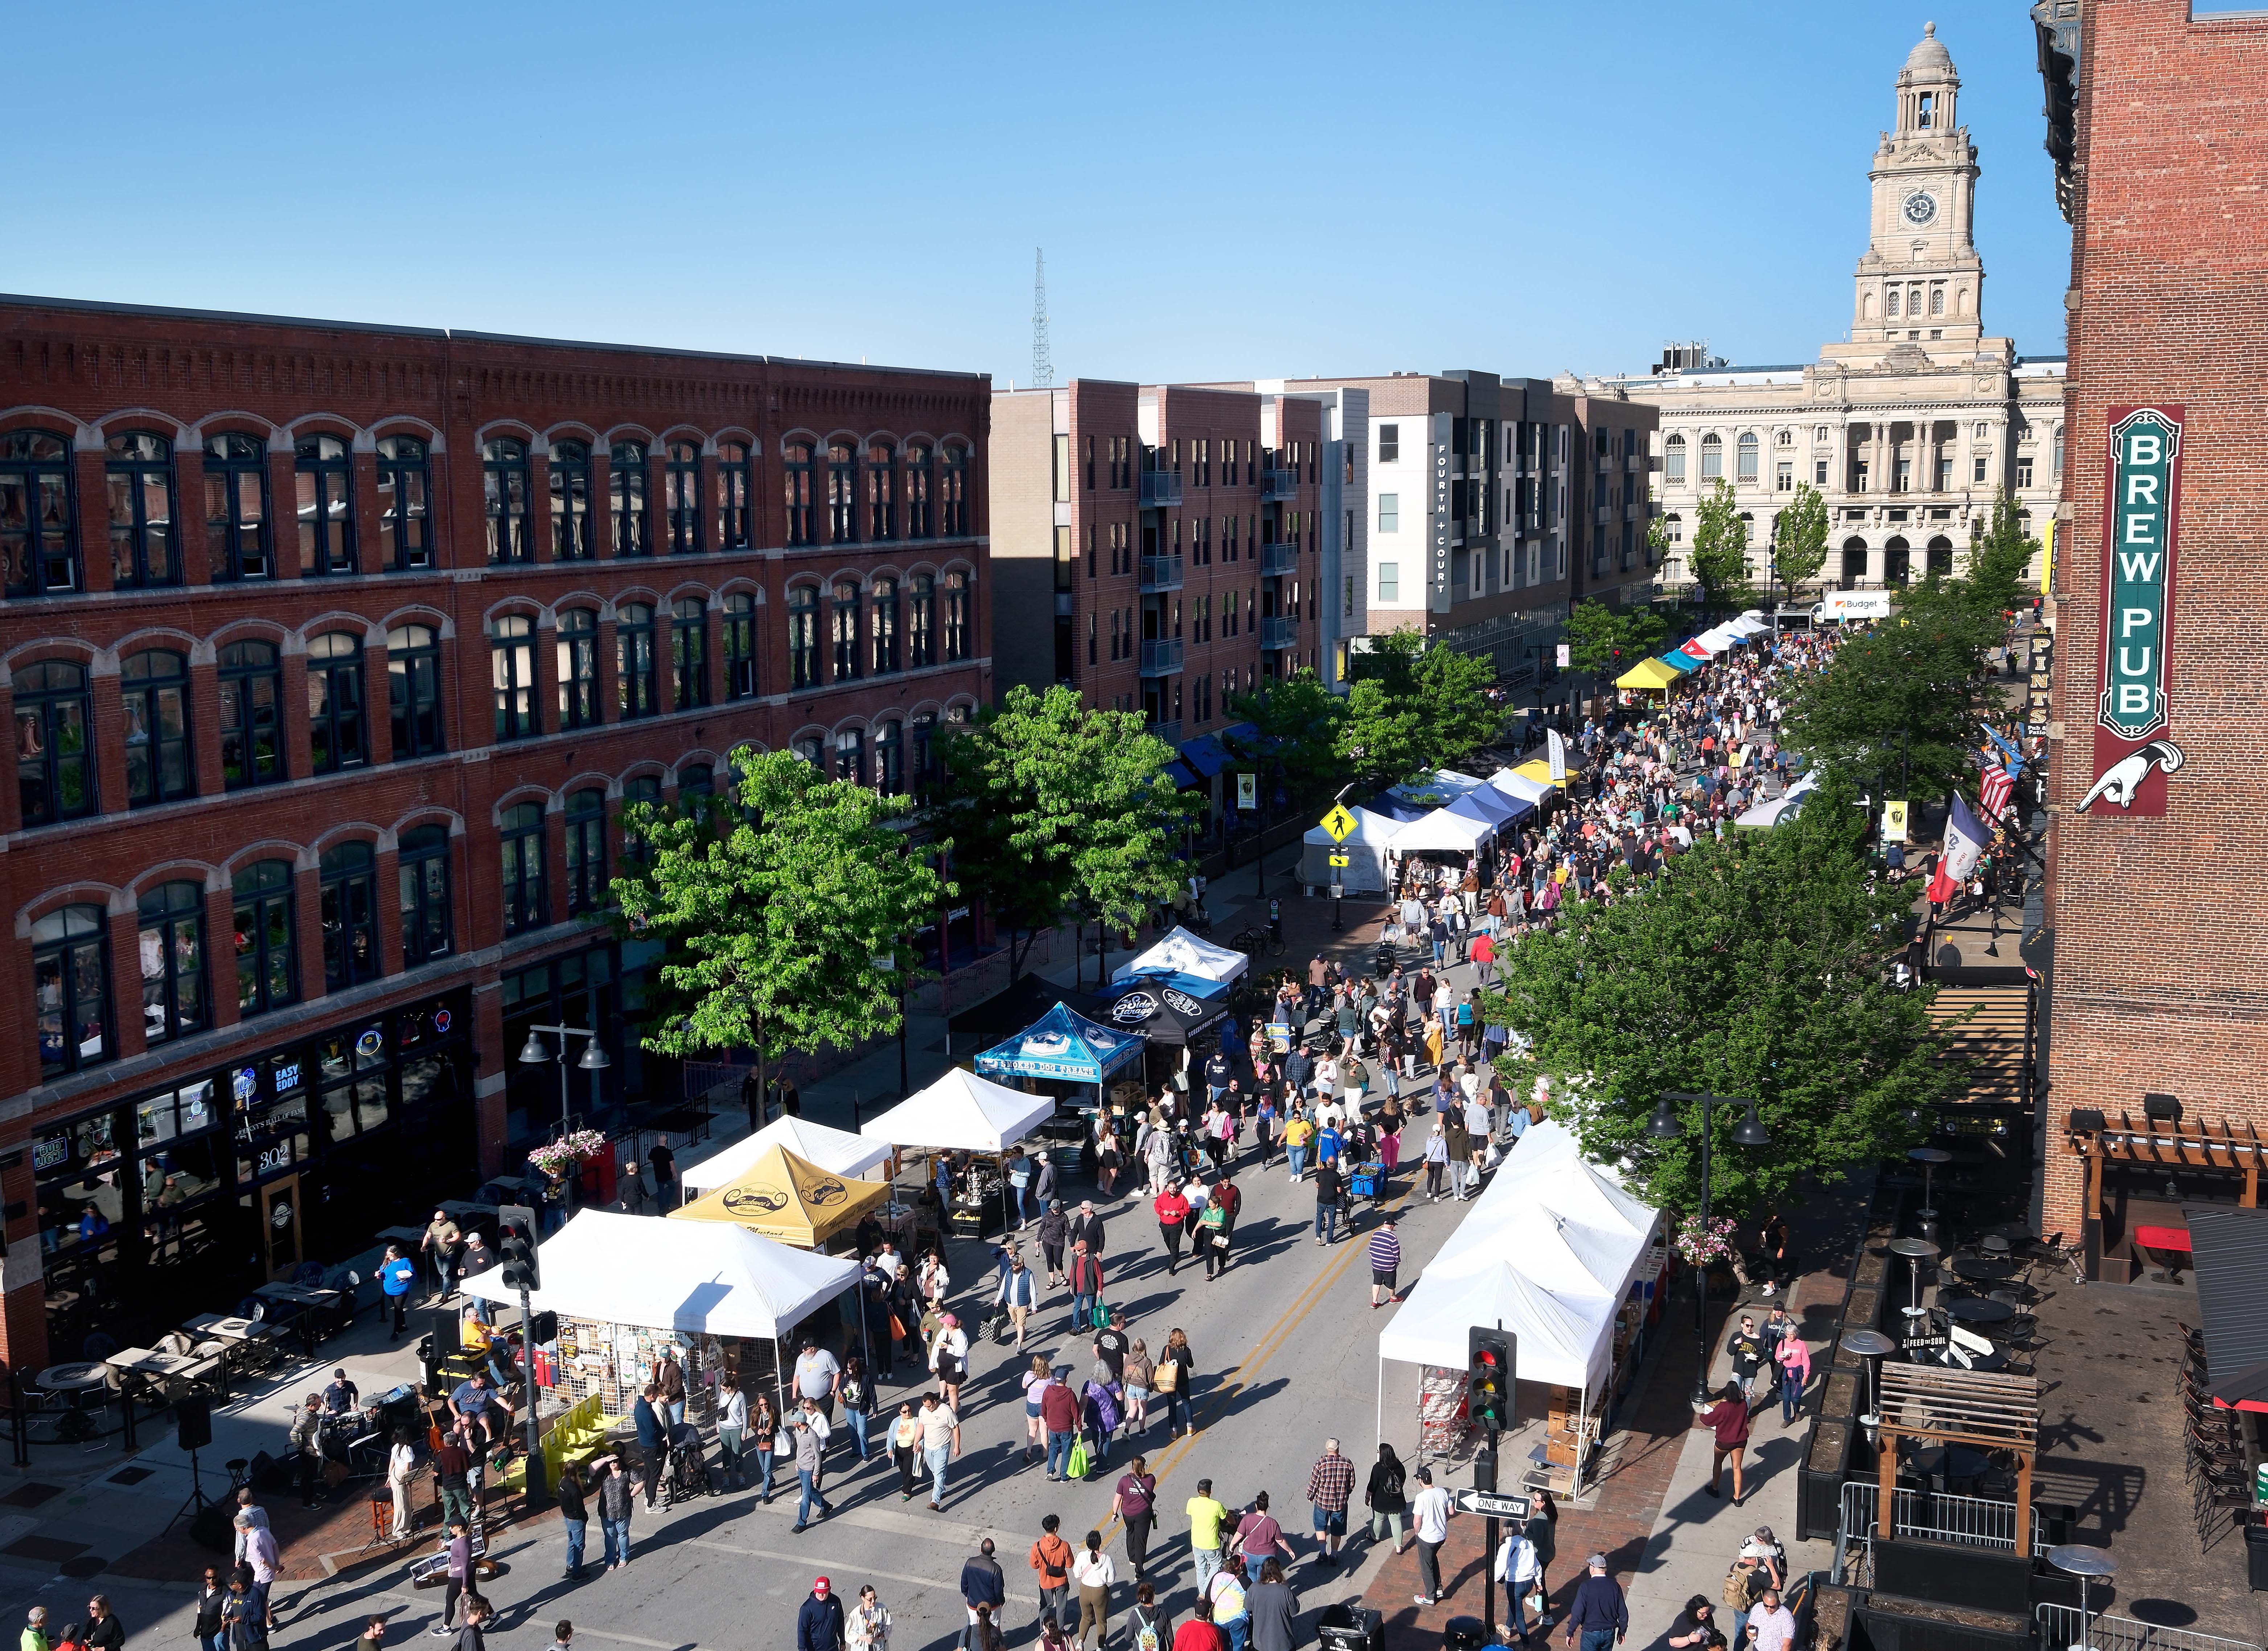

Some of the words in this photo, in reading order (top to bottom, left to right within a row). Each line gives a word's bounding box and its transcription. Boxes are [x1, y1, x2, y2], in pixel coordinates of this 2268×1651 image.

[1931, 380, 1955, 390] HOUSE
[1438, 445, 1446, 513] FOURTH
[2119, 435, 2161, 582] BREW
[1437, 537, 1446, 594] COURT
[1847, 600, 1878, 609] Budget
[2119, 608, 2153, 714] PUB
[2030, 638, 2051, 724] PINTS
[1127, 996, 1151, 1009] Side
[1113, 1003, 1153, 1021] Garage
[1188, 1026, 1202, 1038] SCREEN
[1202, 1020, 1213, 1030] PRINT
[1215, 1009, 1228, 1022] DESIGN
[276, 1063, 299, 1081] EASY
[1001, 1061, 1036, 1070] SMOKED
[1039, 1063, 1056, 1071] DOG
[1060, 1065, 1094, 1075] TREATS
[276, 1074, 299, 1092] EDDY
[266, 1117, 282, 1126] HALL
[290, 1106, 306, 1117] FAME
[40, 1141, 62, 1156] BUD
[260, 1145, 288, 1169] 302
[37, 1149, 66, 1168] LIGHT
[744, 1187, 776, 1196] Magnificent
[830, 1209, 856, 1228] Magnificent
[857, 1198, 875, 1212] Mustard
[1931, 1337, 1946, 1345] SOUL
[1955, 1331, 1967, 1341] BOLD
[1478, 1499, 1497, 1510] ONE
[1501, 1501, 1522, 1513] WAY
